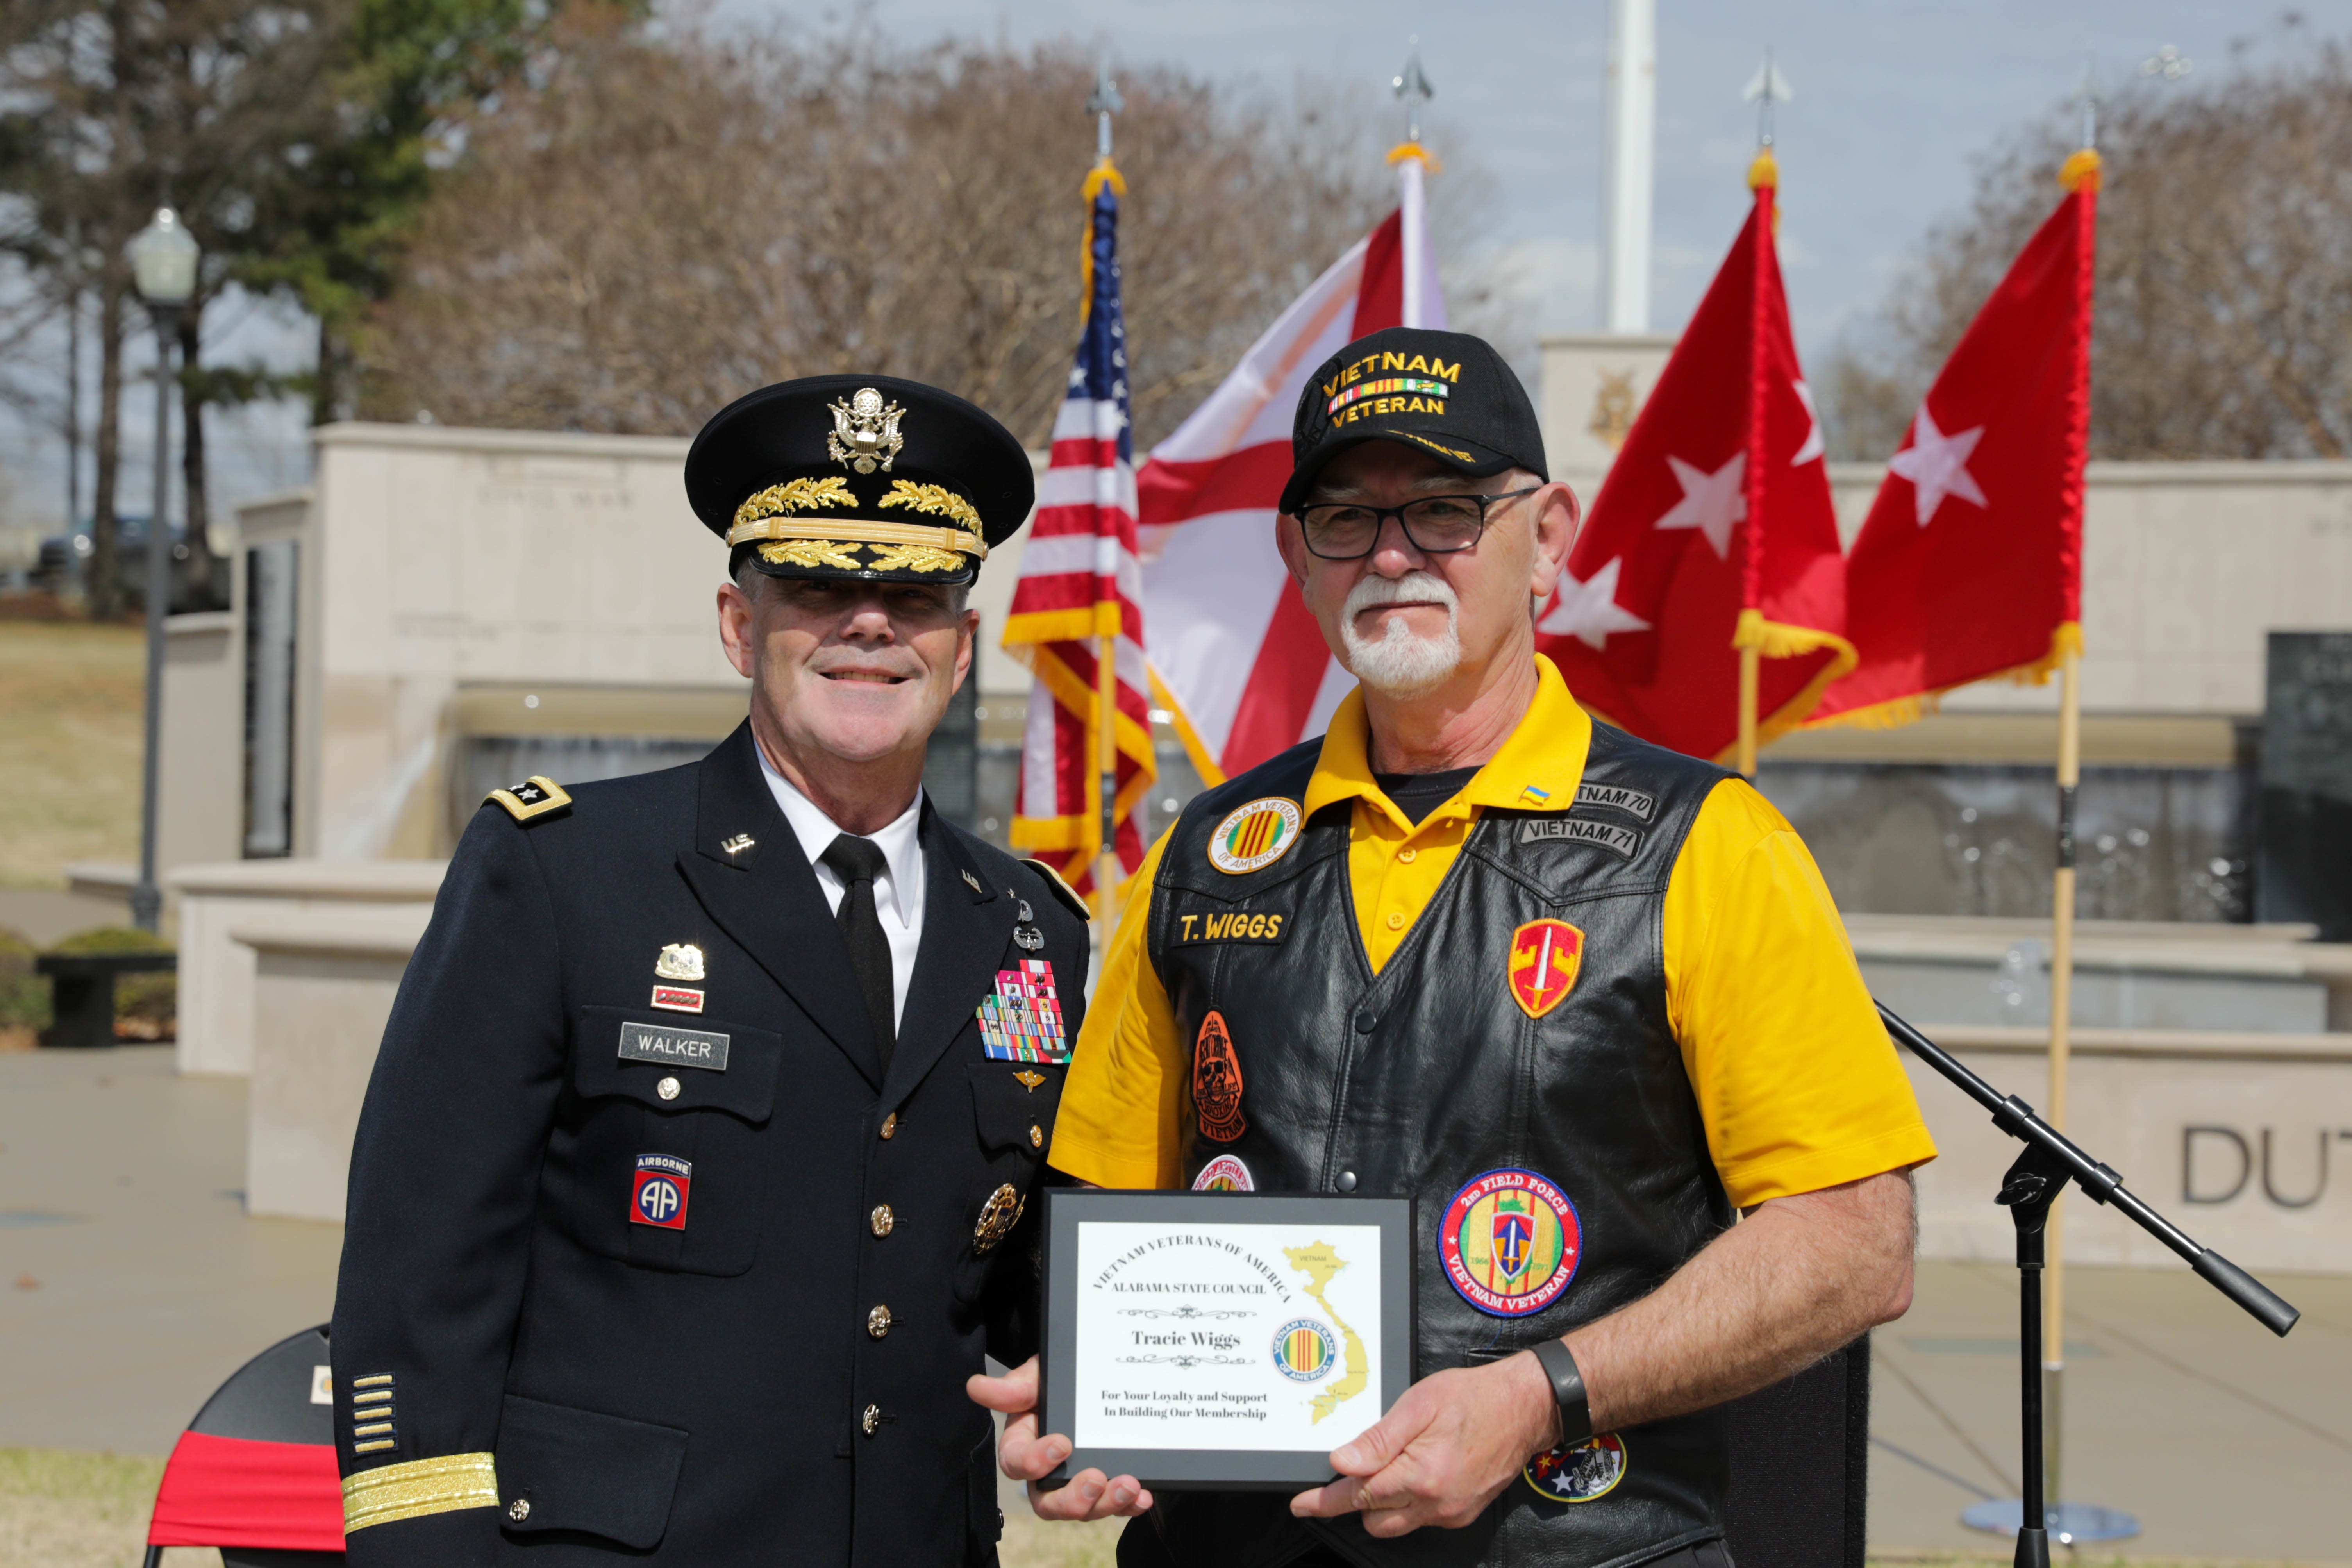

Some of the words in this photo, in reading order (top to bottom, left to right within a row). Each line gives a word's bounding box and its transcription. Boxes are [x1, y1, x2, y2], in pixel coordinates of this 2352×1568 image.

[1323, 352, 1461, 398] VIETNAM
[1332, 396, 1444, 428] VETERAN
[1628, 795, 1650, 811] 70
[1216, 803, 1261, 840] VIETNAM
[1266, 801, 1297, 834] VETERANS
[1528, 821, 1613, 841] VIETNAM
[1613, 830, 1634, 848] 71
[1218, 852, 1232, 863] OF
[1231, 846, 1282, 870] AMERICA
[1181, 915, 1198, 941] T.
[1205, 913, 1283, 940] WIGGS
[638, 1035, 711, 1058] WALKER
[1204, 1113, 1244, 1139] VIETNAM
[638, 1157, 689, 1175] AIRBORNE
[2183, 1126, 2352, 1208] DU
[641, 1180, 678, 1218] AA
[1481, 1175, 1523, 1191] FIELD
[1528, 1178, 1568, 1215] FORCE
[1093, 1245, 1145, 1289] VIETNAM
[1148, 1235, 1222, 1250] VETERANS
[1225, 1242, 1243, 1255] OF
[1243, 1253, 1291, 1303] AMERICA
[1449, 1253, 1504, 1308] VIETNAM
[1506, 1265, 1570, 1310] VETERAN
[1112, 1282, 1170, 1292] ALABAMA
[1173, 1283, 1210, 1293] STATE
[1213, 1284, 1266, 1294] COUNCIL
[1132, 1331, 1186, 1345] Tracie
[1191, 1332, 1241, 1350] Wiggs
[1274, 1321, 1299, 1354] VIETNAM
[1301, 1320, 1335, 1355] VETERANS
[1279, 1363, 1291, 1373] OF
[1289, 1365, 1329, 1380] AMERICA
[1102, 1390, 1121, 1400] For
[1124, 1391, 1150, 1400] Your
[1153, 1391, 1193, 1403] Loyalty
[1197, 1391, 1218, 1401] and
[1221, 1392, 1267, 1404] Support
[1105, 1407, 1116, 1416] In
[1119, 1407, 1168, 1419] Building
[1170, 1408, 1192, 1417] Our
[1195, 1408, 1266, 1421] Membership
